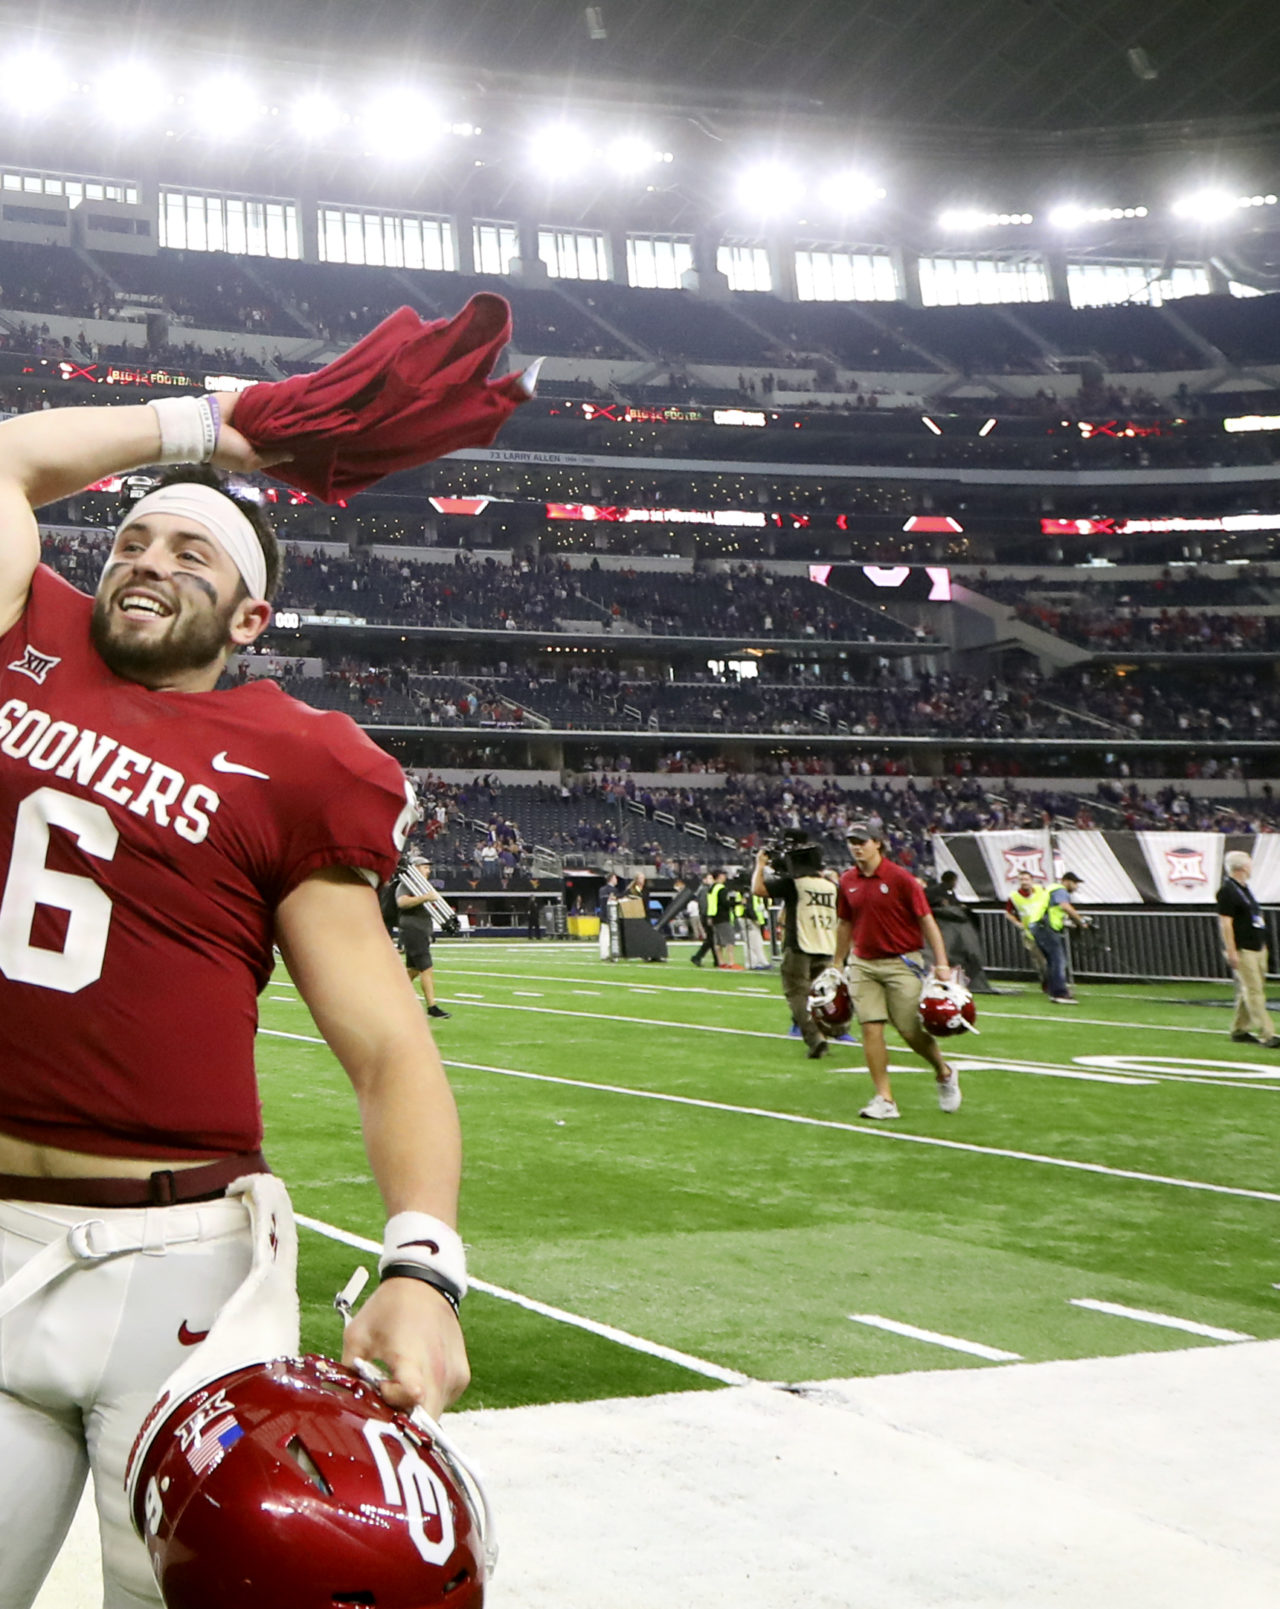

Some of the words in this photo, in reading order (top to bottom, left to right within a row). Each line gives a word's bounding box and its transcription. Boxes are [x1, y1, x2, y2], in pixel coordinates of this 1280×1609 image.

[503, 452, 531, 460] LARRY
[533, 454, 561, 462] ALLEN
[805, 890, 835, 909] XII
